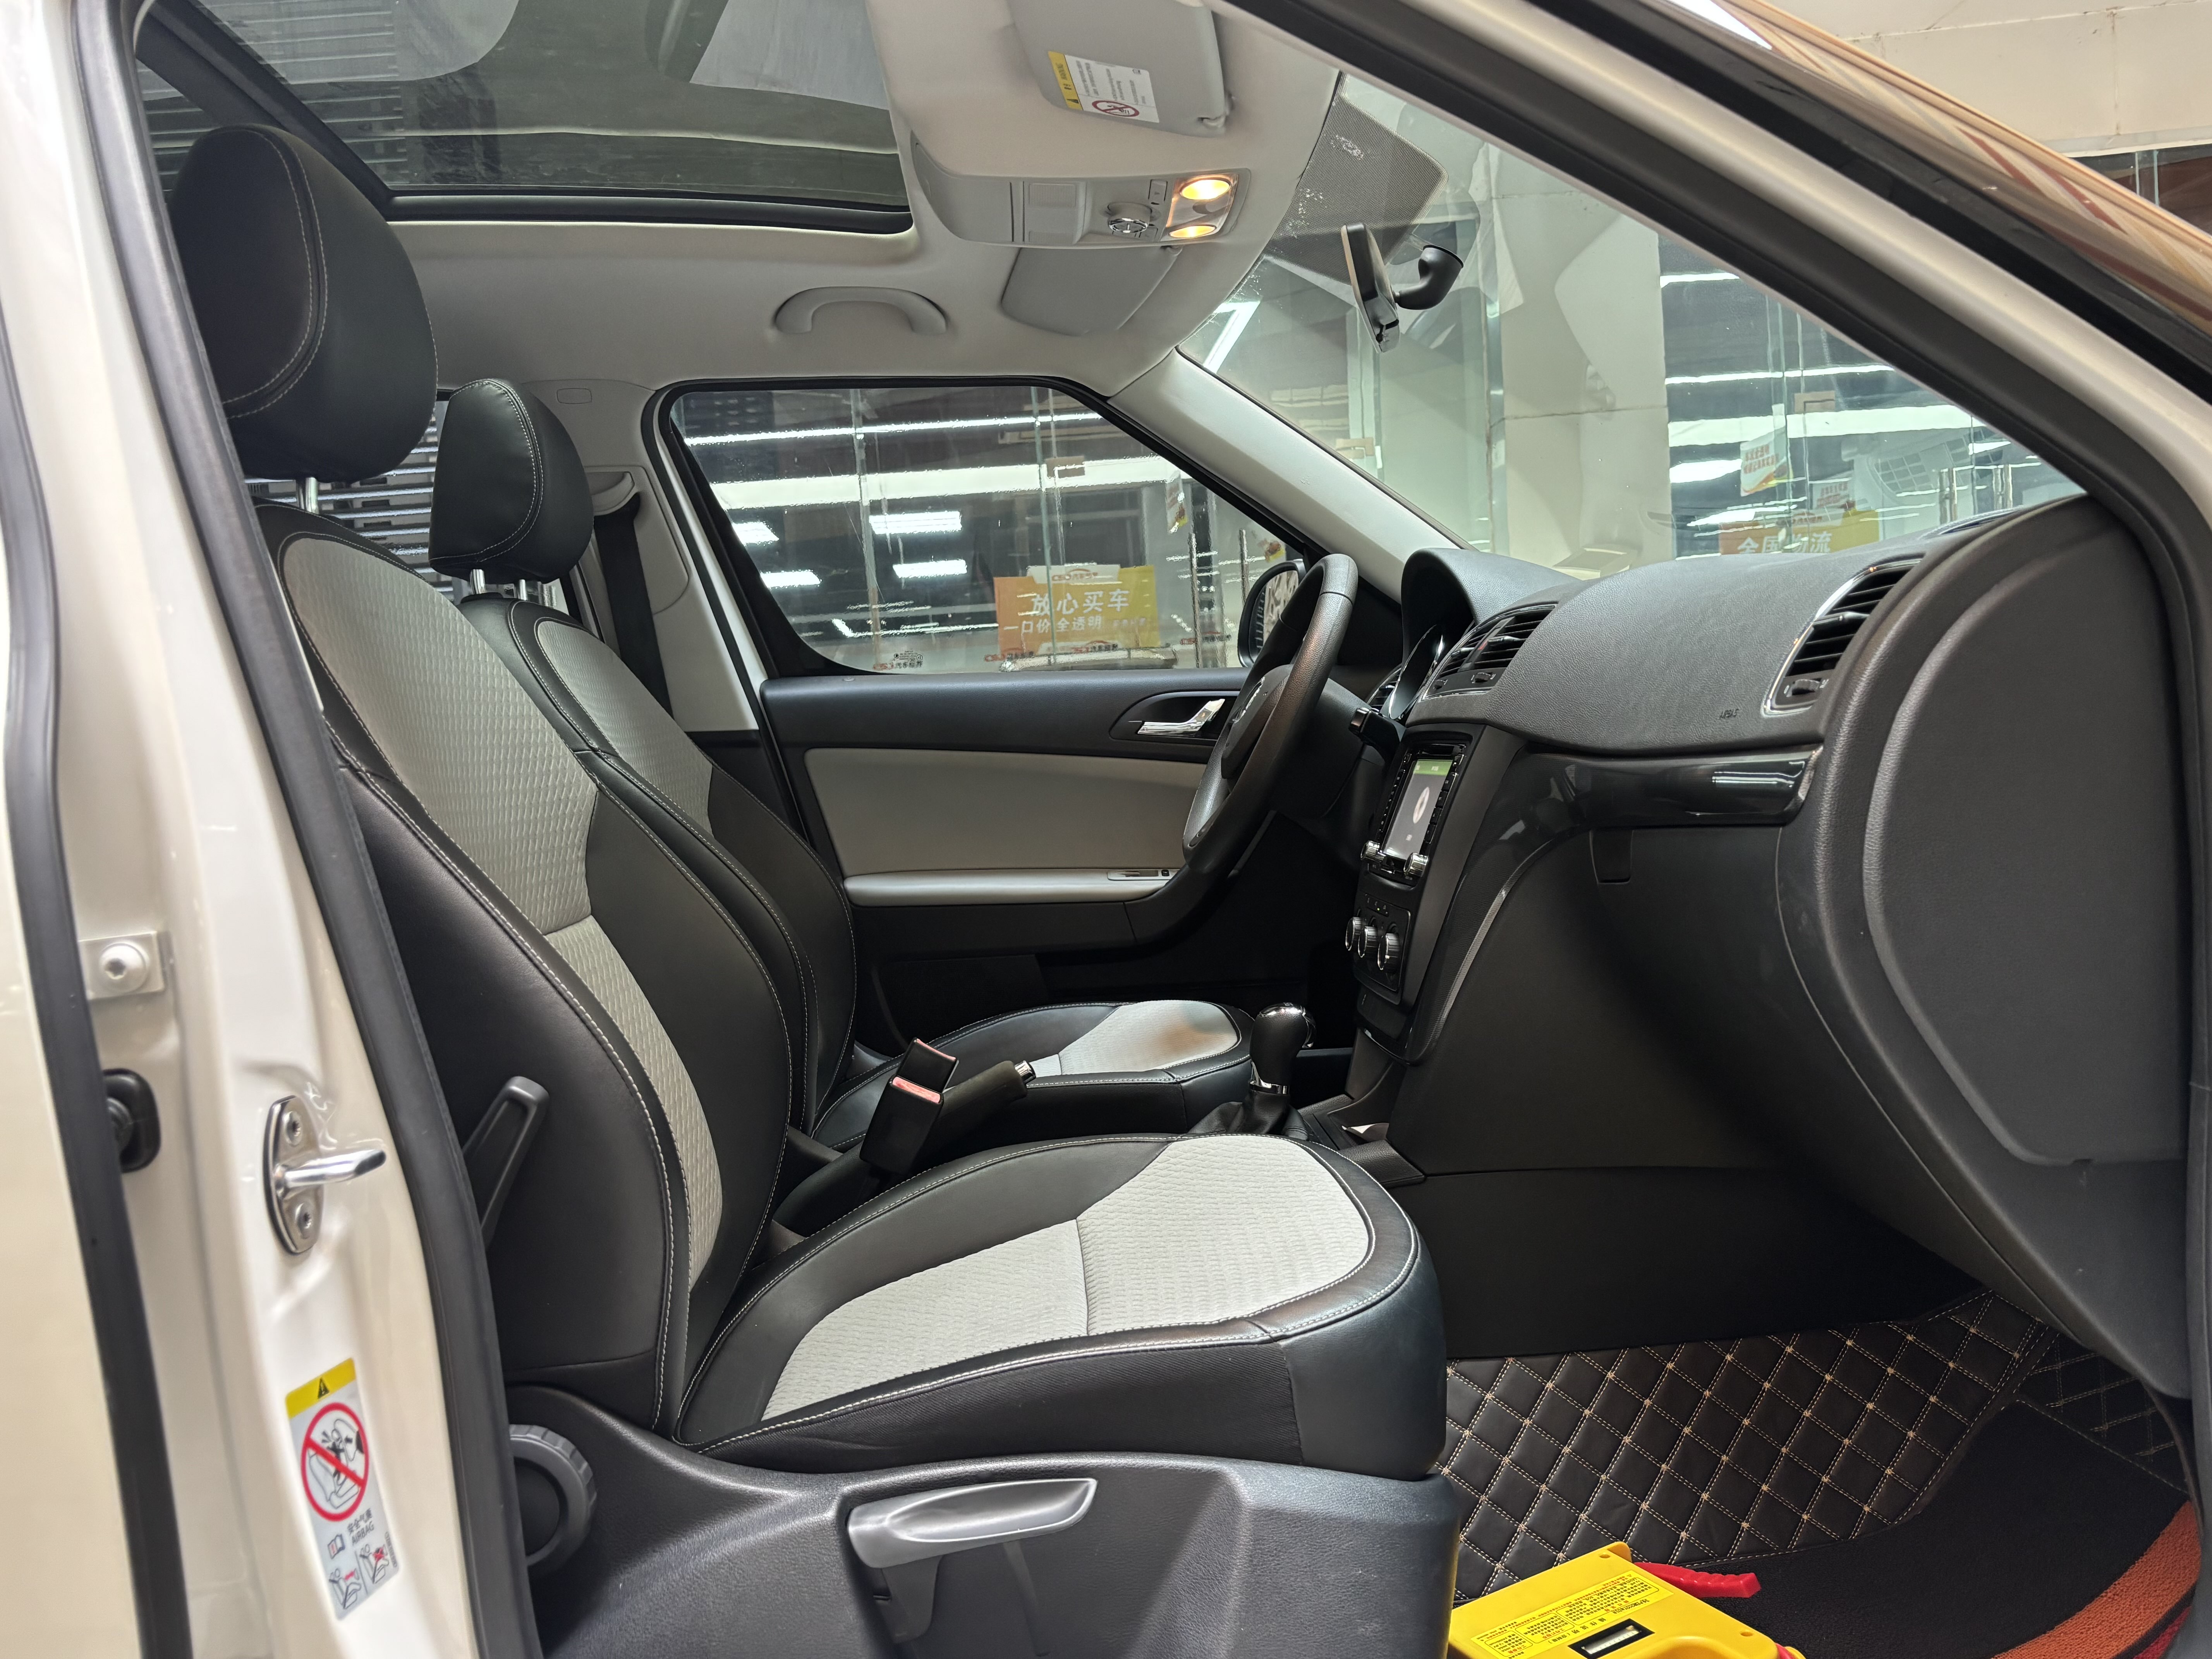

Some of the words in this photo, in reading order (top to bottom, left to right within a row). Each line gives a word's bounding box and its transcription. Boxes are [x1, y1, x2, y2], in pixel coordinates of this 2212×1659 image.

[1031, 589, 1130, 616] 放心买车
[1004, 616, 1102, 634] 一口价全透明
[352, 1521, 374, 1546] AIRBAG
